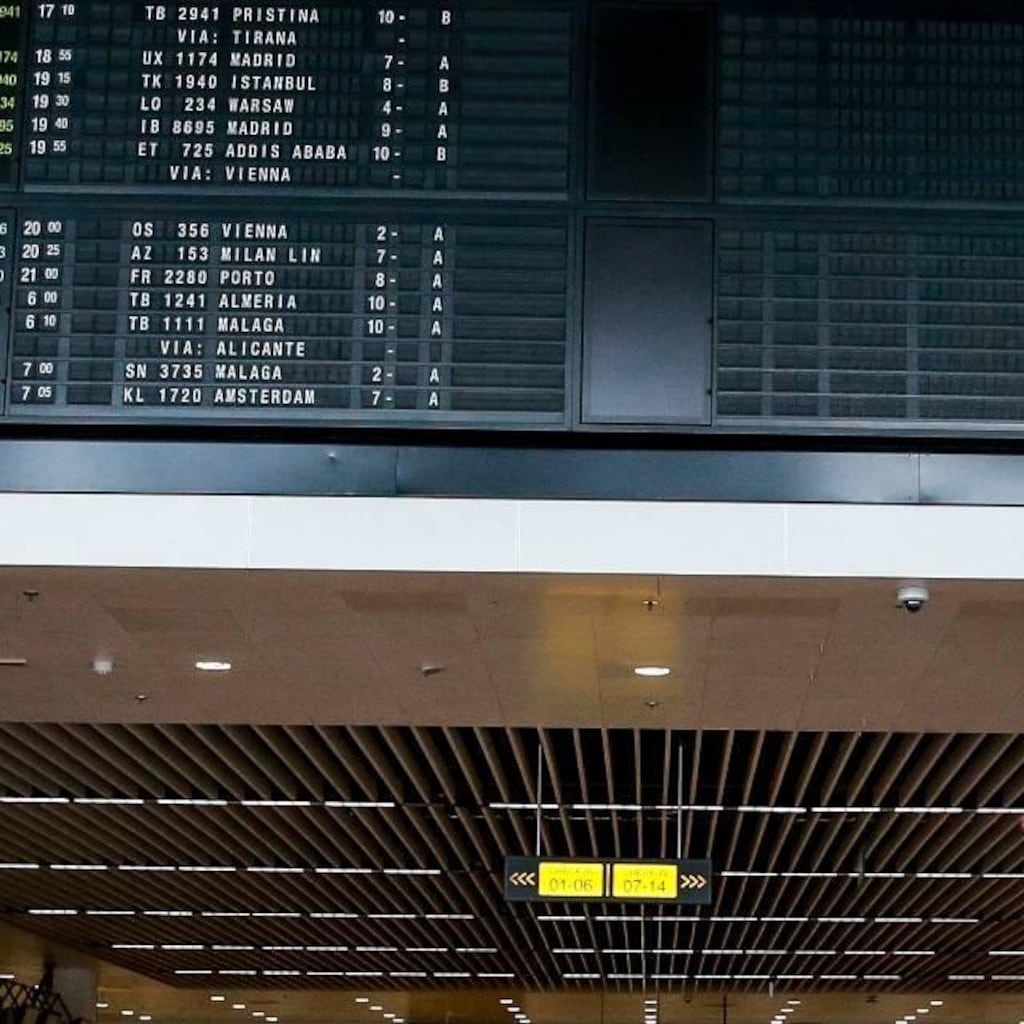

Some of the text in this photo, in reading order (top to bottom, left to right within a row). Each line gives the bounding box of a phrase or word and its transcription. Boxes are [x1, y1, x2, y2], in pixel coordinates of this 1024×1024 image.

[39, 4, 54, 18] 17
[63, 4, 74, 15] 10
[146, 6, 165, 20] TB
[179, 7, 218, 21] 2941
[233, 7, 319, 23] PRISTINA
[442, 11, 450, 24] B
[178, 29, 296, 45] VIA: TIRANA
[36, 49, 51, 63] 18
[59, 49, 71, 60] 55
[143, 51, 162, 65] UX
[177, 52, 217, 66] 1174
[230, 53, 295, 67] MADRID
[440, 56, 449, 69] A
[34, 71, 50, 85] 19
[58, 72, 71, 83] 15
[142, 74, 161, 88] TK
[176, 75, 217, 89] 1940
[232, 75, 315, 90] ISTANBUL
[440, 79, 449, 92] B
[33, 94, 48, 108] 19
[56, 95, 69, 106] 30
[141, 97, 161, 111] LO
[185, 97, 215, 111] 234
[229, 98, 293, 113] WARSAW
[439, 102, 447, 115] A
[32, 118, 47, 132] 19
[55, 118, 68, 129] 40
[142, 119, 159, 133] IB
[172, 120, 214, 134] 8695
[227, 121, 292, 135] MADRID
[438, 124, 447, 138] A
[30, 140, 45, 154] 19
[53, 140, 66, 151] 55
[138, 142, 158, 156] ET
[183, 143, 213, 157] 725
[226, 144, 279, 158] ADDIS
[292, 145, 346, 159] ABABA
[437, 147, 445, 161] B
[170, 166, 290, 181] VIA: VIENNA
[24, 221, 41, 235] 20
[48, 221, 61, 232] 00
[133, 222, 153, 237] OS
[178, 223, 209, 237] 356
[222, 224, 287, 238] VIENNA
[434, 227, 443, 241] A
[22, 244, 39, 258] 20
[47, 244, 60, 255] 25
[131, 246, 151, 260] AZ
[178, 246, 208, 261] 153
[221, 247, 276, 261] MILAN
[289, 248, 320, 262] LIN
[433, 251, 442, 264] A
[21, 268, 36, 282] 21
[45, 268, 58, 279] 00
[131, 269, 151, 283] FR
[165, 270, 207, 284] 2280
[220, 270, 274, 285] PORTO
[433, 274, 442, 287] A
[28, 291, 36, 305] 6
[44, 291, 57, 303] 00
[130, 292, 149, 306] TB
[165, 293, 204, 307] 1241
[219, 294, 296, 308] ALMERIA
[433, 297, 442, 311] A
[26, 315, 34, 329] 6
[44, 315, 56, 326] 10
[129, 316, 149, 330] TB
[164, 317, 203, 331] 1111
[218, 317, 283, 332] MALAGA
[432, 321, 441, 334] A
[161, 340, 304, 357] VIA: ALICANTE
[23, 362, 32, 376] 7
[39, 363, 53, 373] 00
[126, 363, 146, 378] SN
[160, 364, 202, 378] 3735
[216, 364, 281, 380] MALAGA
[430, 368, 439, 382] A
[22, 386, 31, 400] 7
[38, 386, 51, 397] 05
[124, 388, 144, 402] KL
[160, 388, 201, 402] 1720
[214, 388, 314, 404] AMSTERDAM
[429, 392, 438, 406] A
[549, 878, 593, 892] 01-06
[623, 879, 666, 893] 07-14
